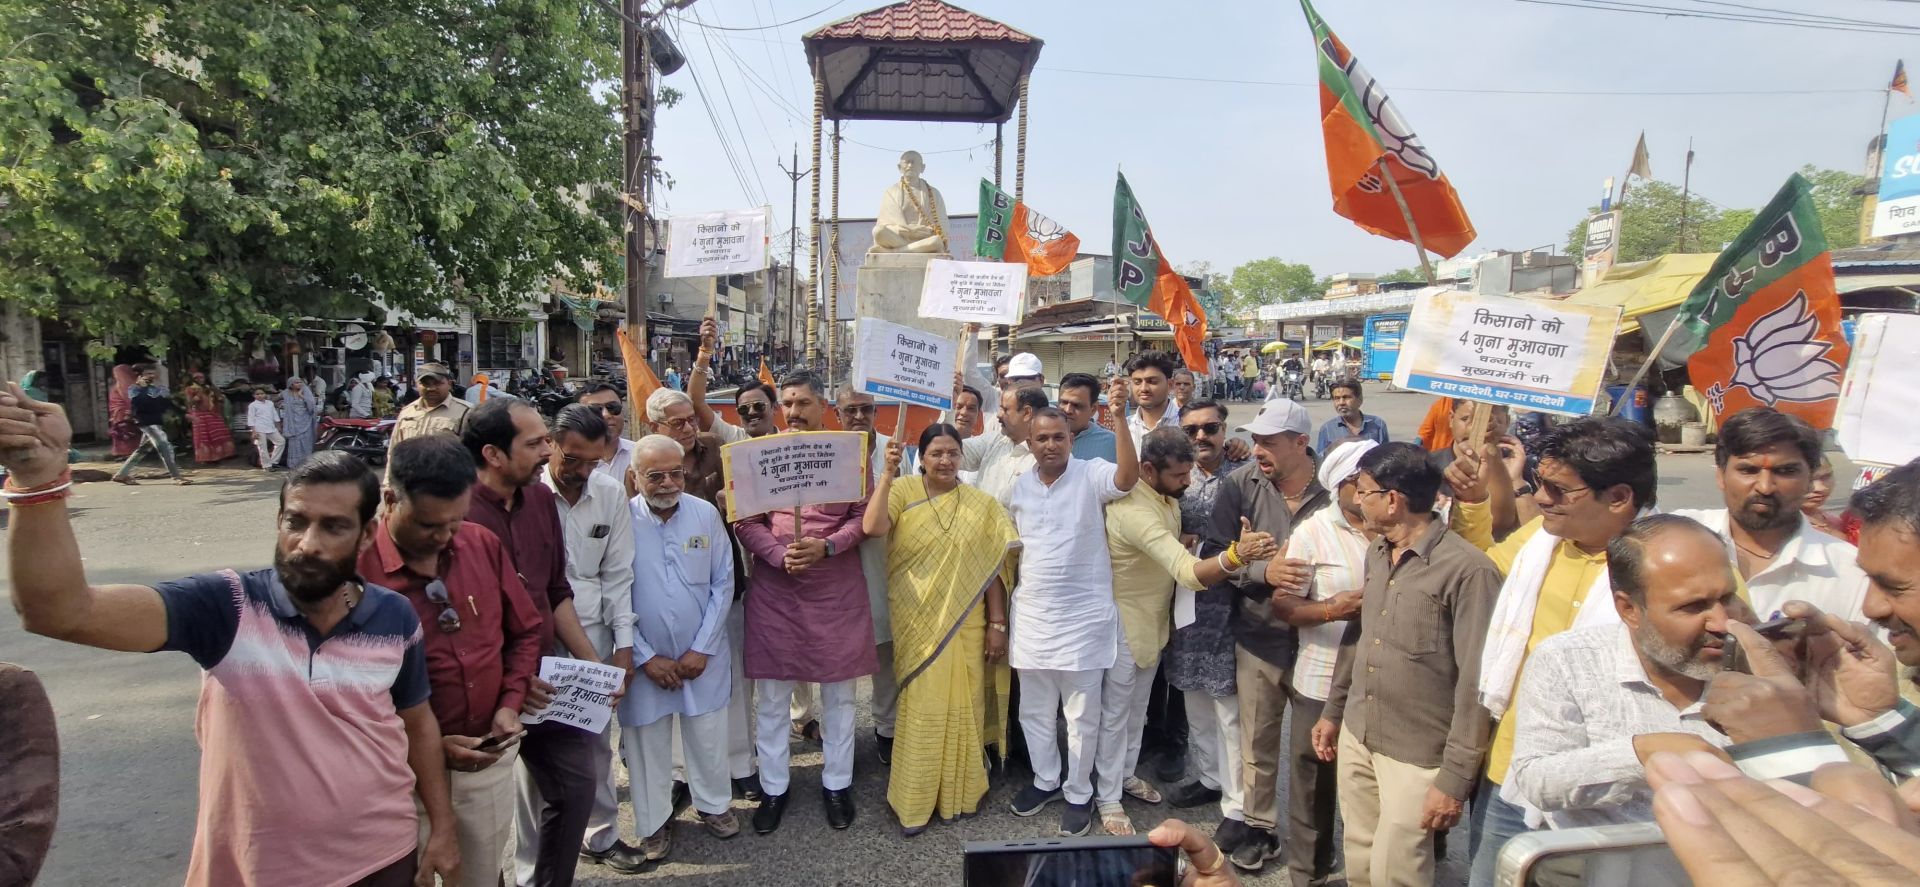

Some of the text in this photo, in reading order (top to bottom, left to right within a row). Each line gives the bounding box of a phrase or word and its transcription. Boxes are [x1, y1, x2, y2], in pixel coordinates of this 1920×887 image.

[698, 222, 741, 234] किसानो को
[986, 192, 1009, 244] BJP
[692, 238, 697, 247] 4
[700, 237, 714, 250] गुना
[1119, 205, 1152, 290] JP
[950, 286, 954, 295] 4
[957, 287, 972, 298] गुना
[1474, 308, 1565, 335] किसानो को
[897, 334, 938, 355] किसानो को
[1460, 330, 1568, 359] 4 गुना मुआवजा
[891, 349, 940, 371] 4 गुना मुआवजा
[1480, 355, 1535, 369] धन्यवाद
[1461, 365, 1552, 385] मुख्यमंत्री जी
[1430, 380, 1565, 407] हर घर स्वदेशी, घर-घर स्वदेशी
[761, 460, 833, 478] 4 गुना मुआवजा
[779, 474, 815, 483] धन्यवाद
[579, 717, 592, 725] जी
